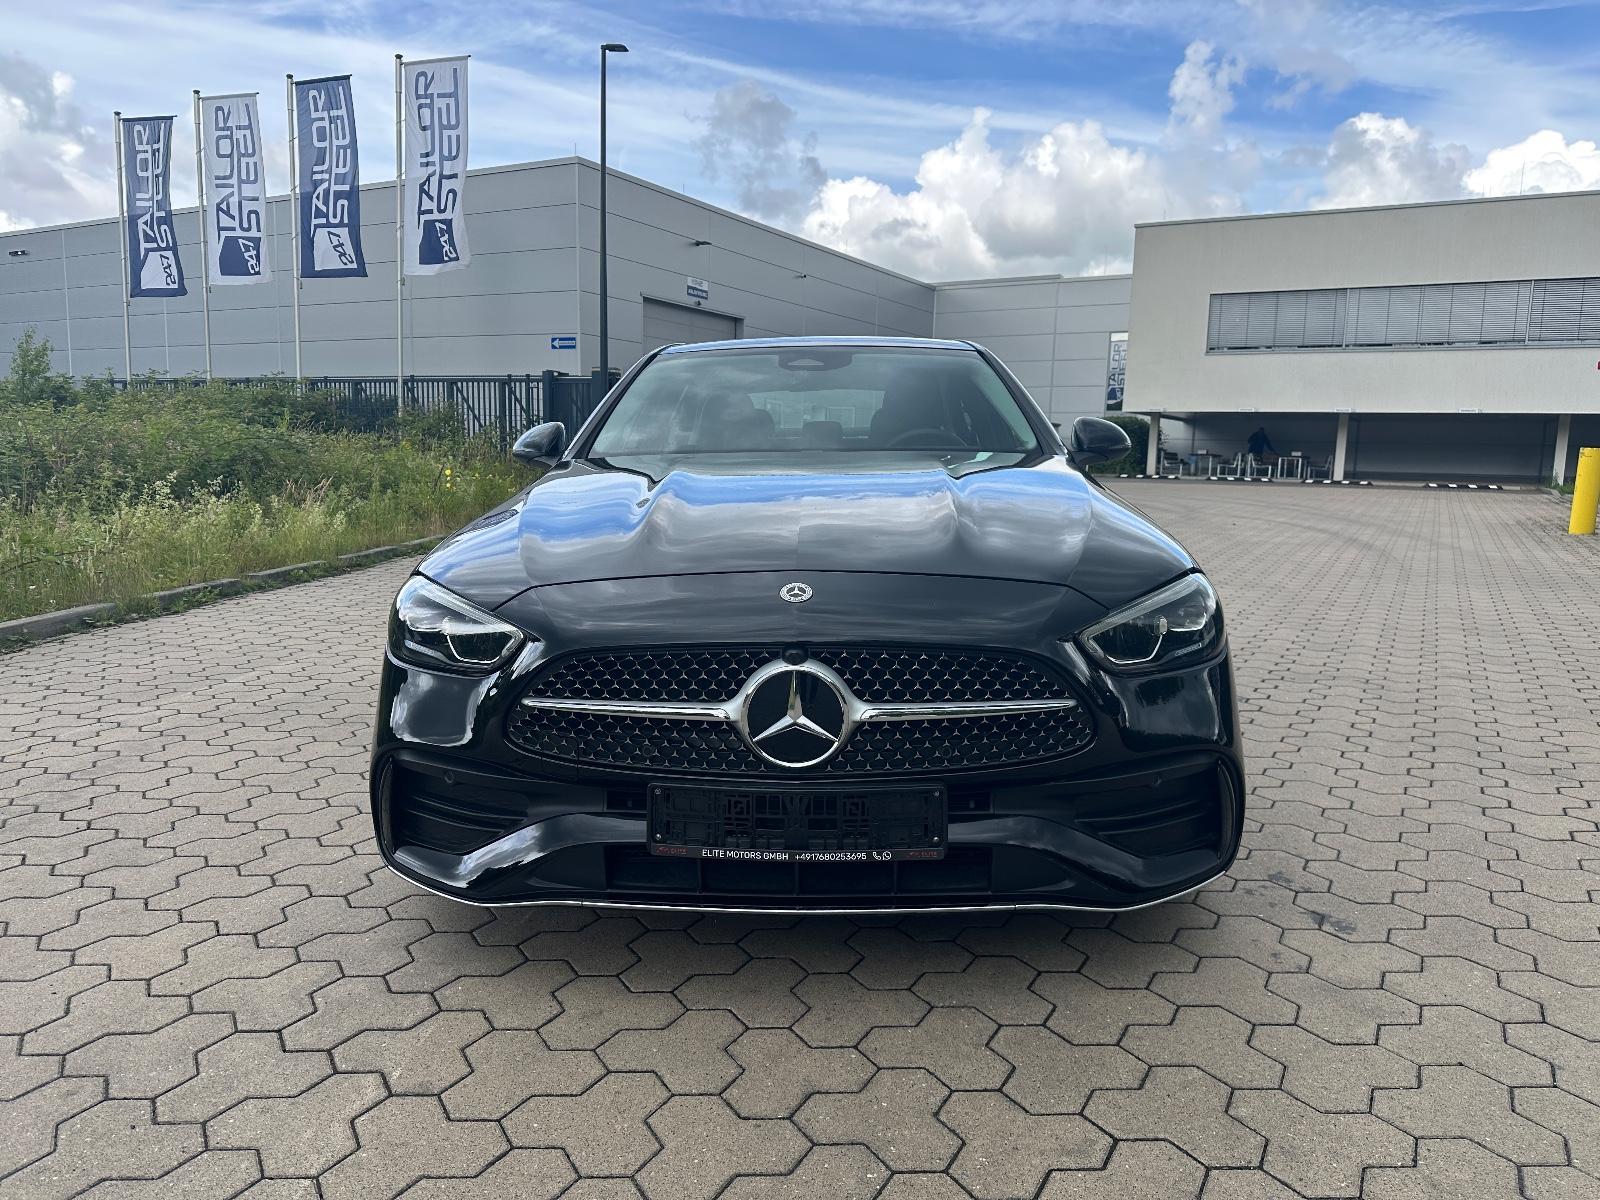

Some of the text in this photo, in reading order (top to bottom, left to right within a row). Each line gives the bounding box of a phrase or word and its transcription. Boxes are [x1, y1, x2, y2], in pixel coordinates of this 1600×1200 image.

[134, 124, 158, 258] TAILOR
[151, 122, 173, 248] STEEL
[215, 104, 236, 244] TAILOR
[236, 103, 262, 233] STEEL
[309, 88, 328, 237] TAILOR
[328, 86, 352, 225] STEEL
[416, 70, 435, 230] TAILOR
[436, 68, 459, 214] STEEL
[160, 253, 177, 286] 247
[239, 238, 260, 275] 247
[328, 230, 354, 266] 247
[435, 221, 458, 262] 247
[702, 849, 867, 861] ELITE MOTORS GMBH +4917680253695
